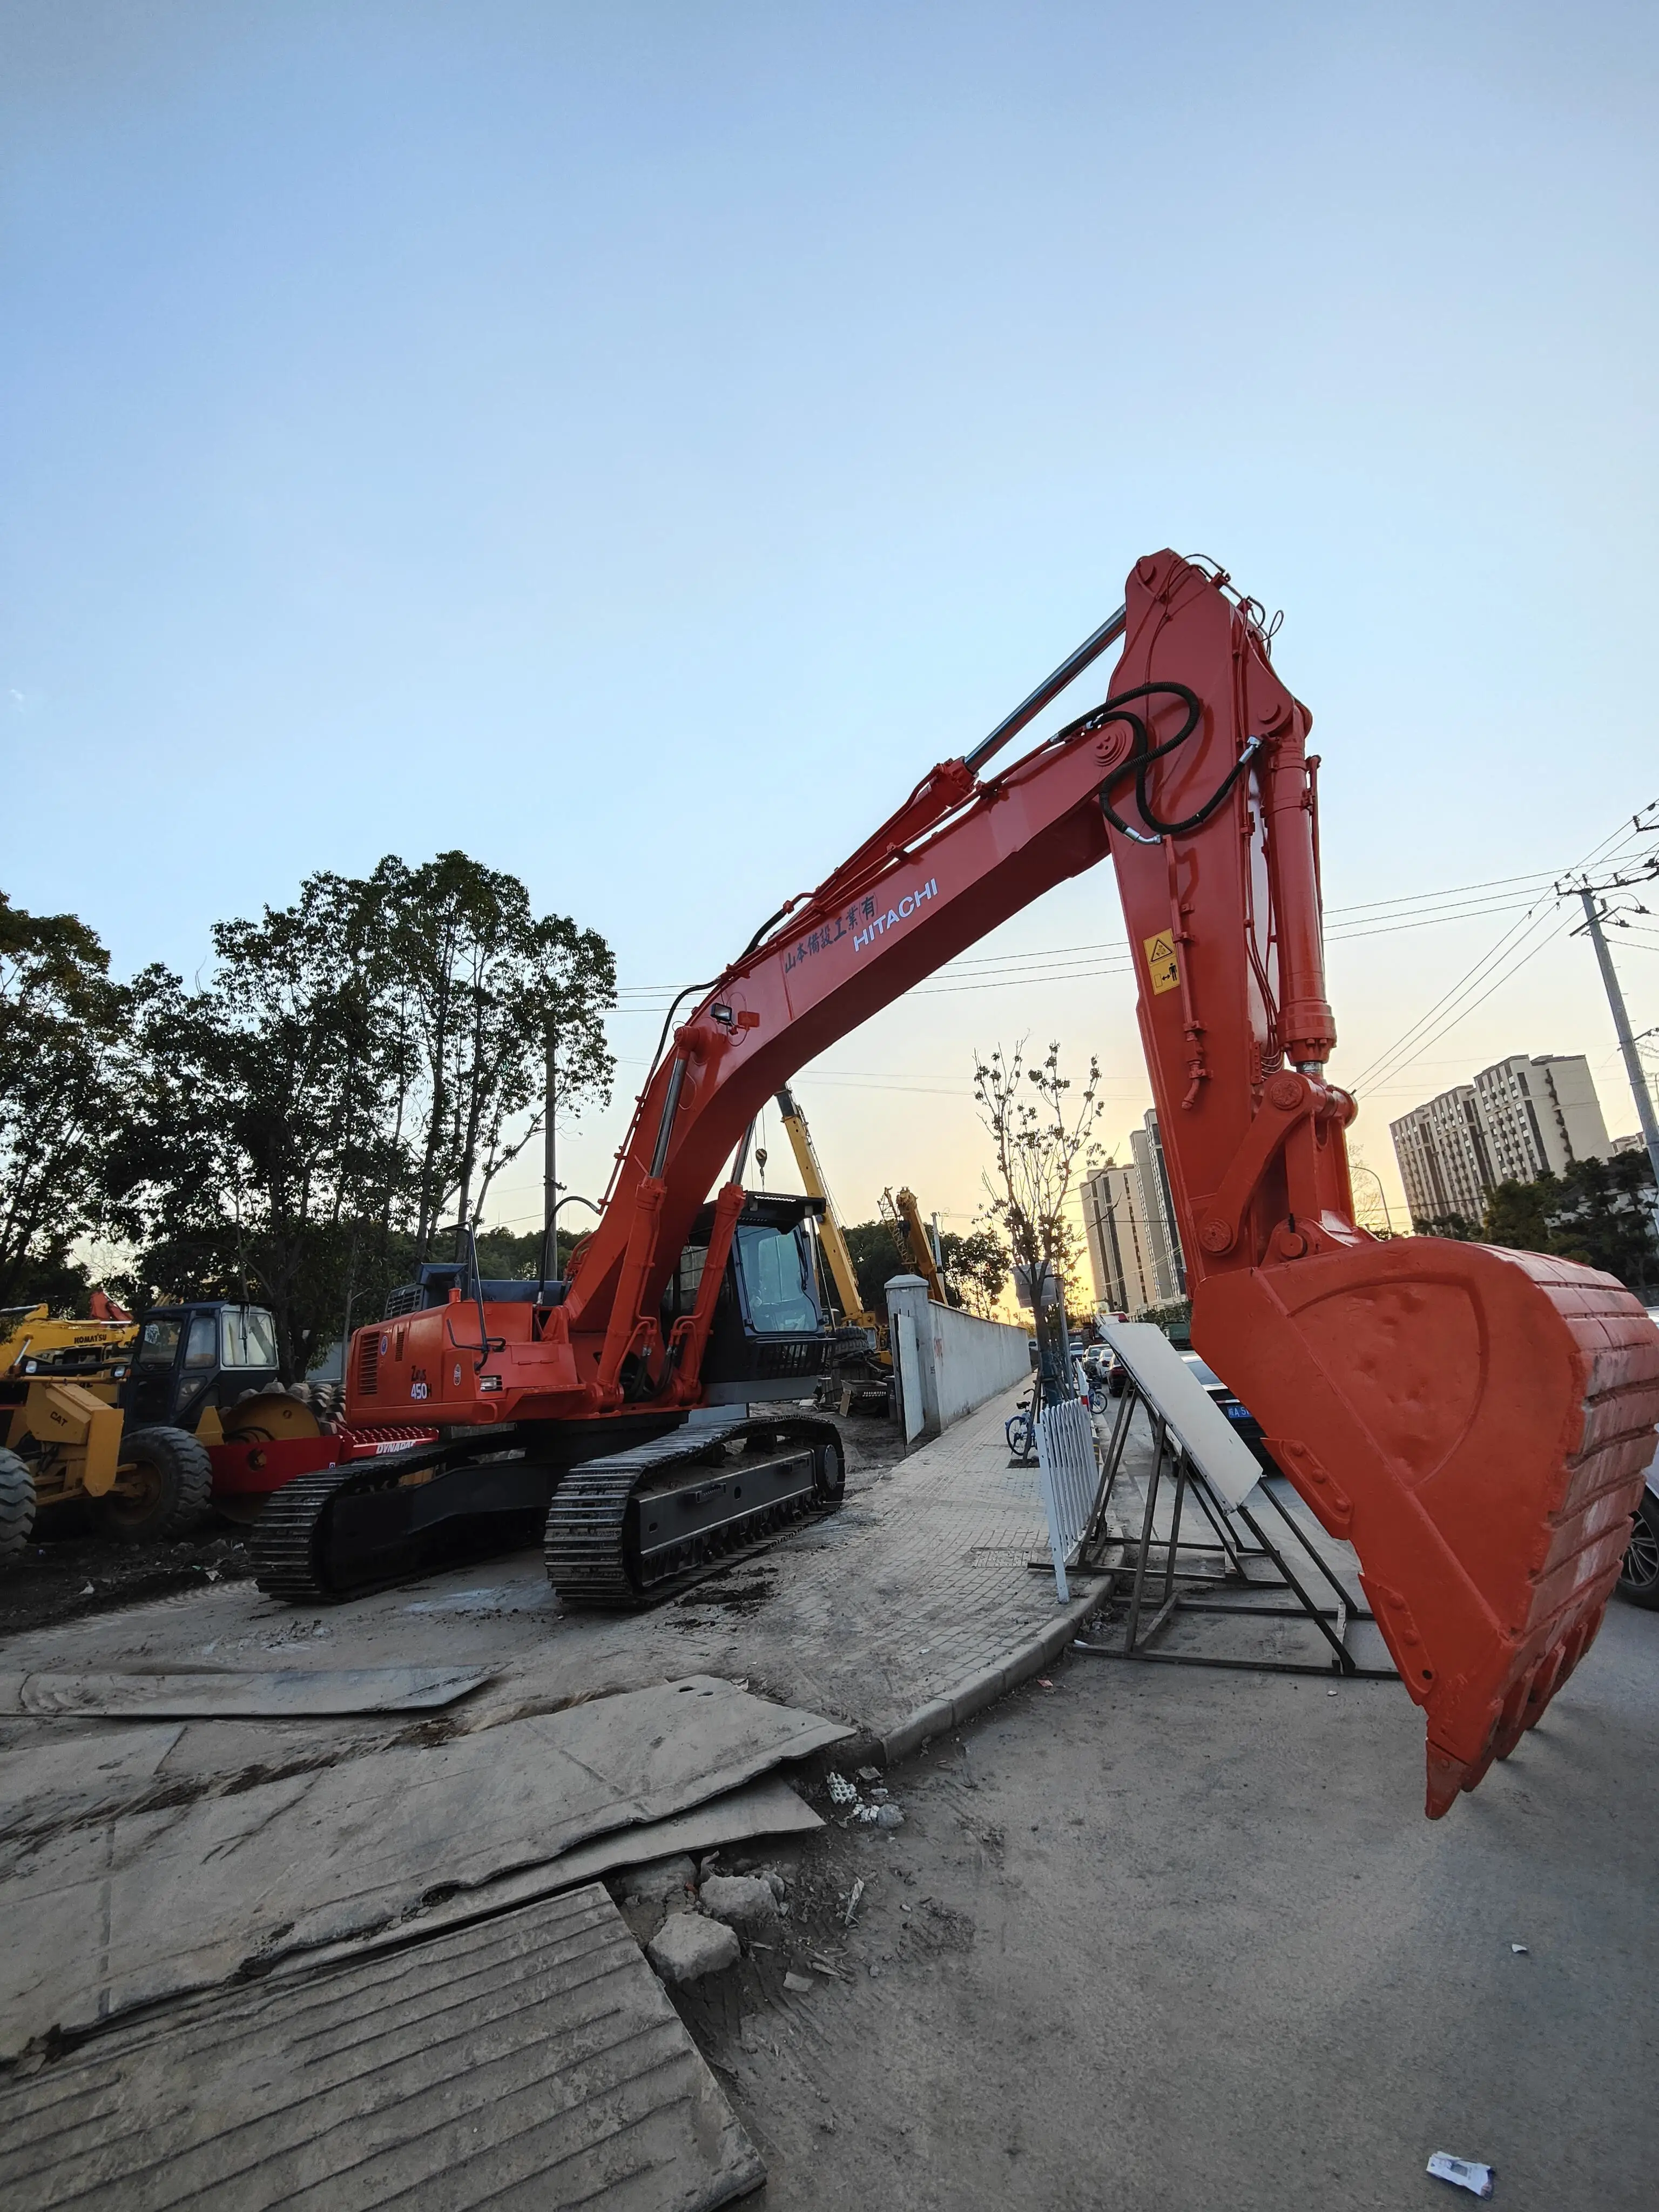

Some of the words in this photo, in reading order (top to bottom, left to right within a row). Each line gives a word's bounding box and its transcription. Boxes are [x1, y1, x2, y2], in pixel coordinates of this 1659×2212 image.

[853, 878, 938, 952] HITACHI
[74, 1333, 107, 1344] KOMATSU
[50, 1411, 68, 1426] CAT
